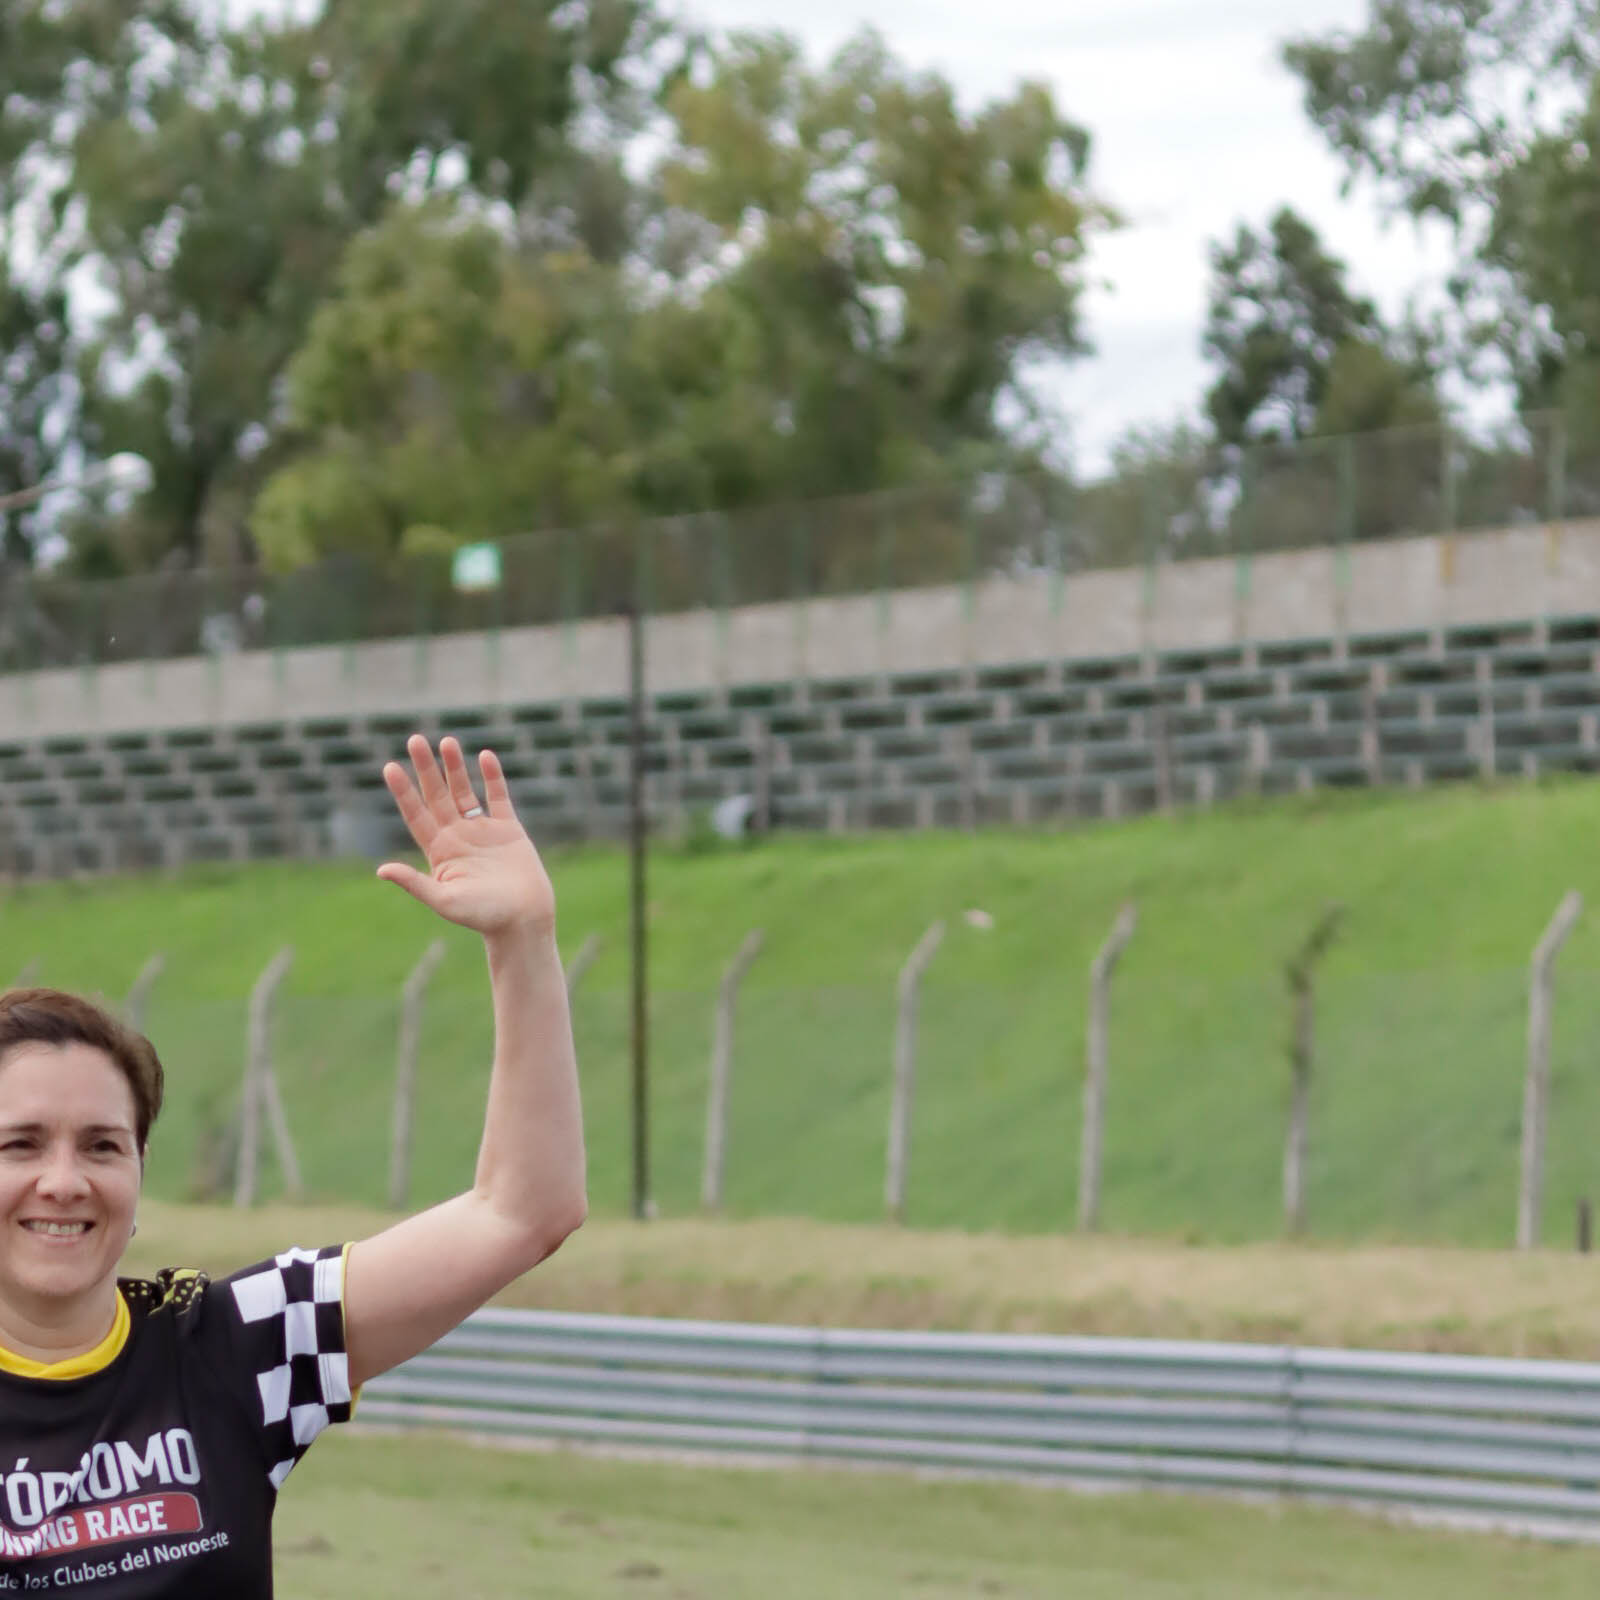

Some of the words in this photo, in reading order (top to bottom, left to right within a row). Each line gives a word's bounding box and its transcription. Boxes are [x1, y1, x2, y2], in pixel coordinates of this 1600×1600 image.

[84, 1500, 168, 1541] RACE
[24, 1574, 49, 1590] los
[54, 1561, 117, 1587] Clubes
[121, 1549, 150, 1573] del
[153, 1531, 230, 1564] Noroeste
